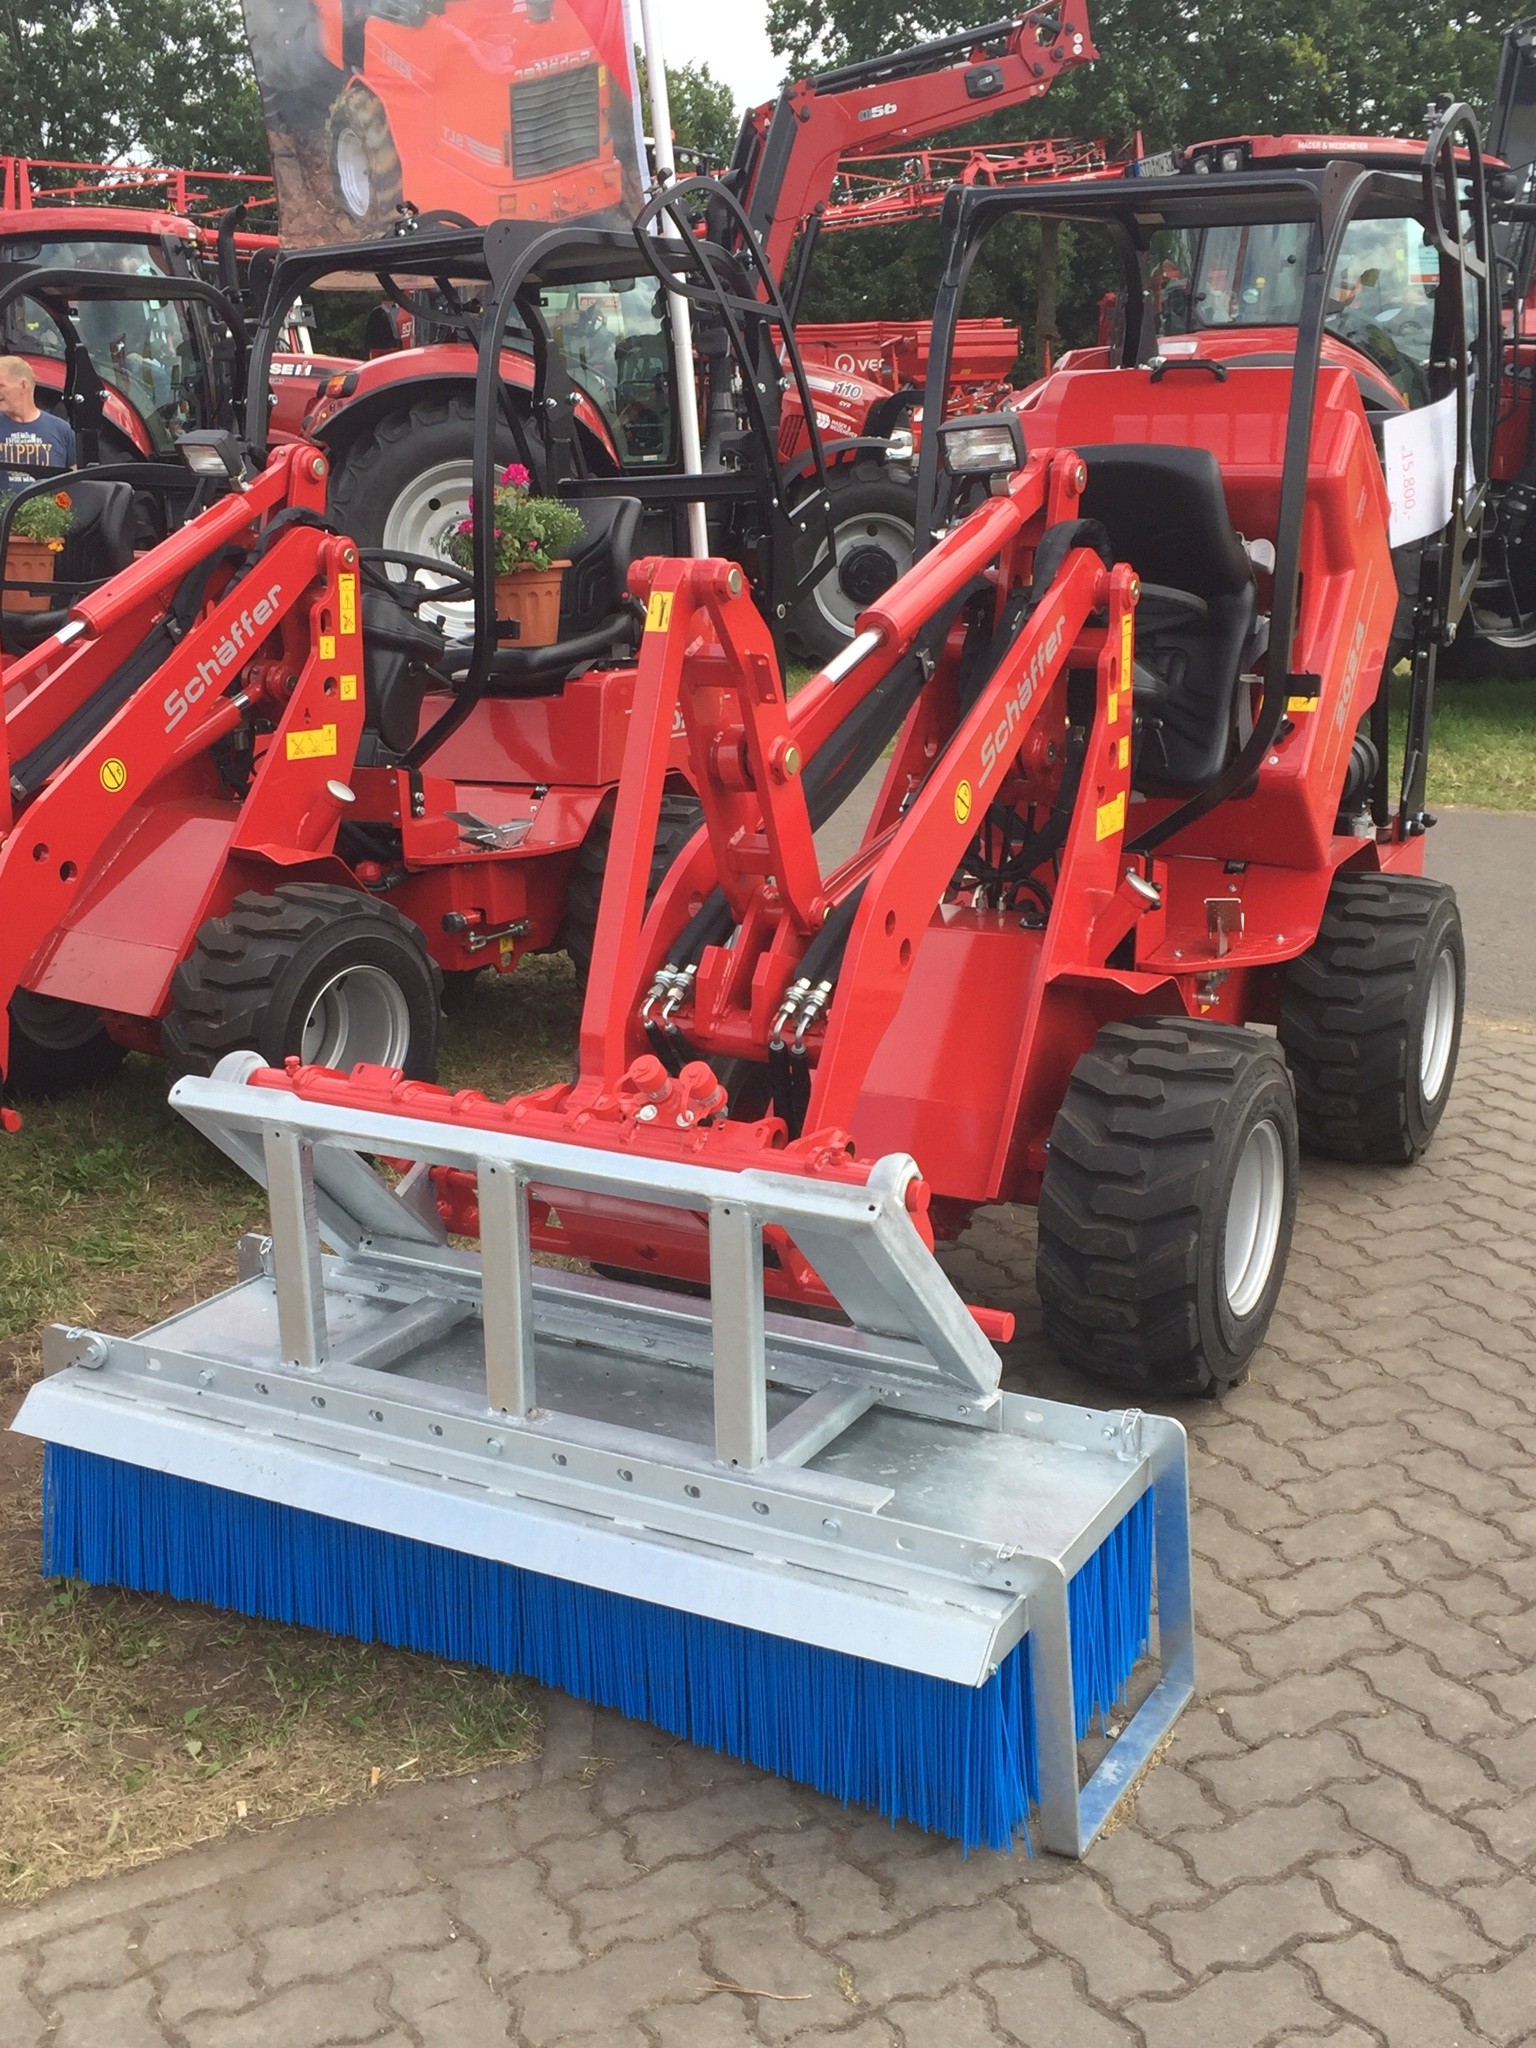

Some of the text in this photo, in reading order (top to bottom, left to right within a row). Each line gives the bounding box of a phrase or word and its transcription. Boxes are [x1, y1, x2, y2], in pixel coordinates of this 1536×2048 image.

[835, 380, 863, 400] 110
[164, 584, 282, 734] Schäffer
[978, 614, 1066, 788] Schäffer
